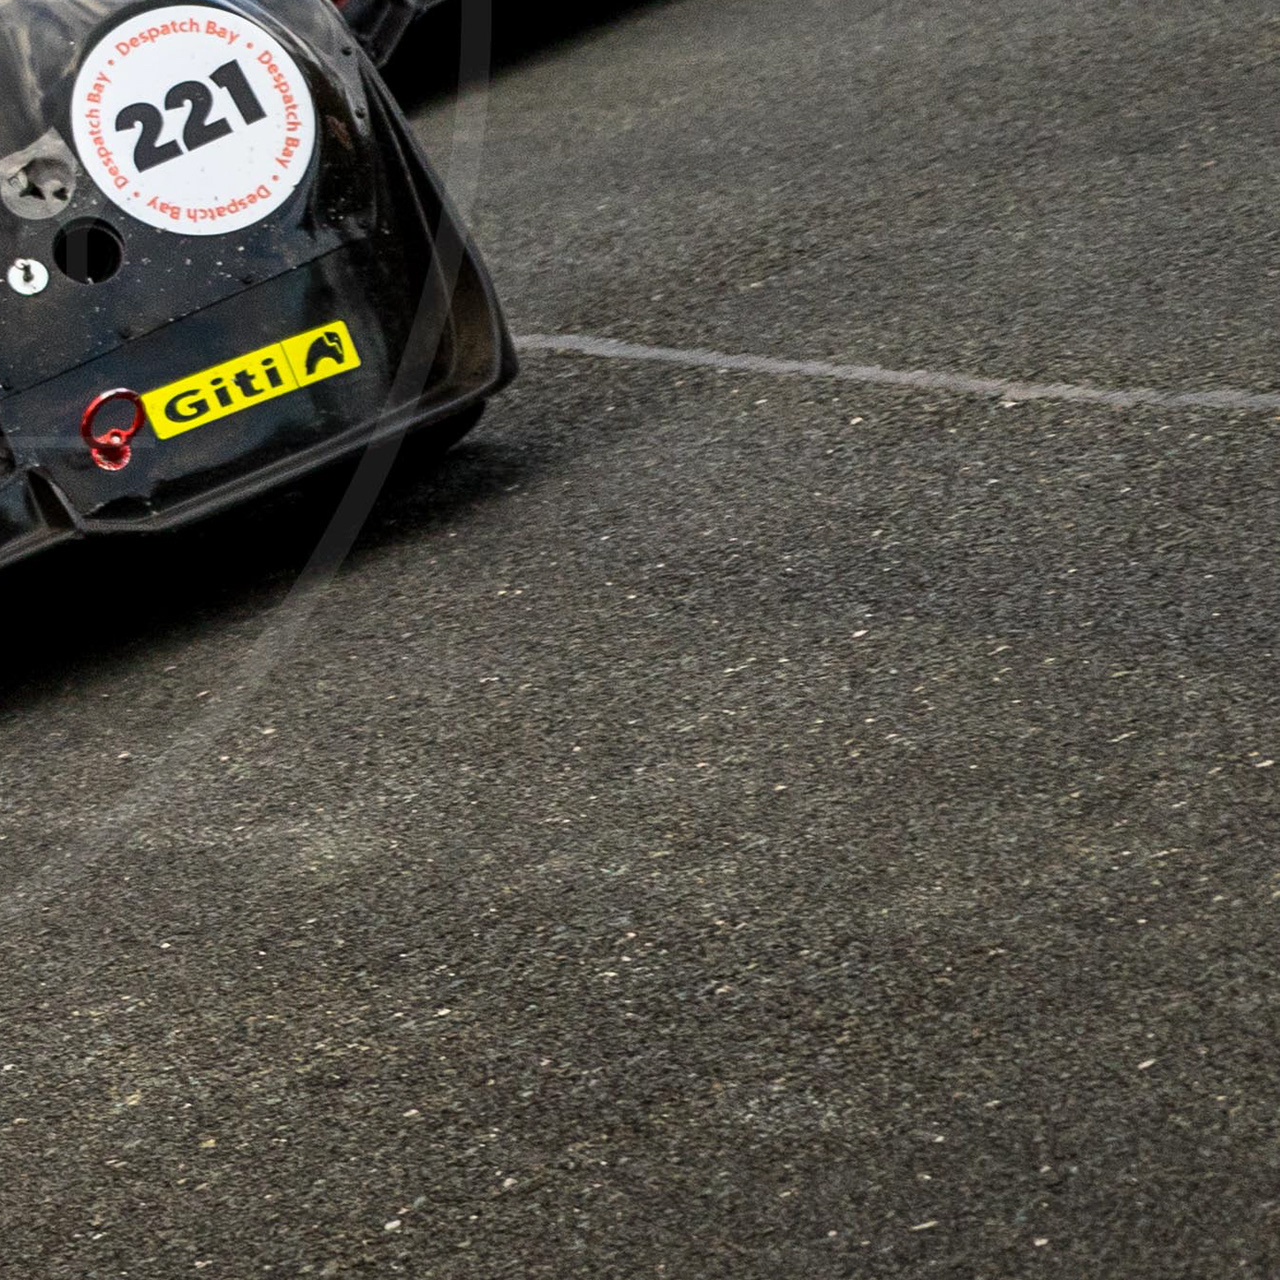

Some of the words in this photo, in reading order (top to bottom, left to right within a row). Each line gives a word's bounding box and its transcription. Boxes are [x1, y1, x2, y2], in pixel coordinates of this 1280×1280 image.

[114, 17, 200, 57] Despatch
[204, 19, 240, 45] Bay
[86, 71, 113, 105] Bay
[256, 49, 303, 133] Despatch
[114, 58, 268, 174] 221
[84, 110, 130, 191] Despatch
[275, 137, 301, 170] Bay
[146, 195, 182, 221] Bay
[185, 184, 272, 223] Despatch
[162, 356, 288, 429] Giti
